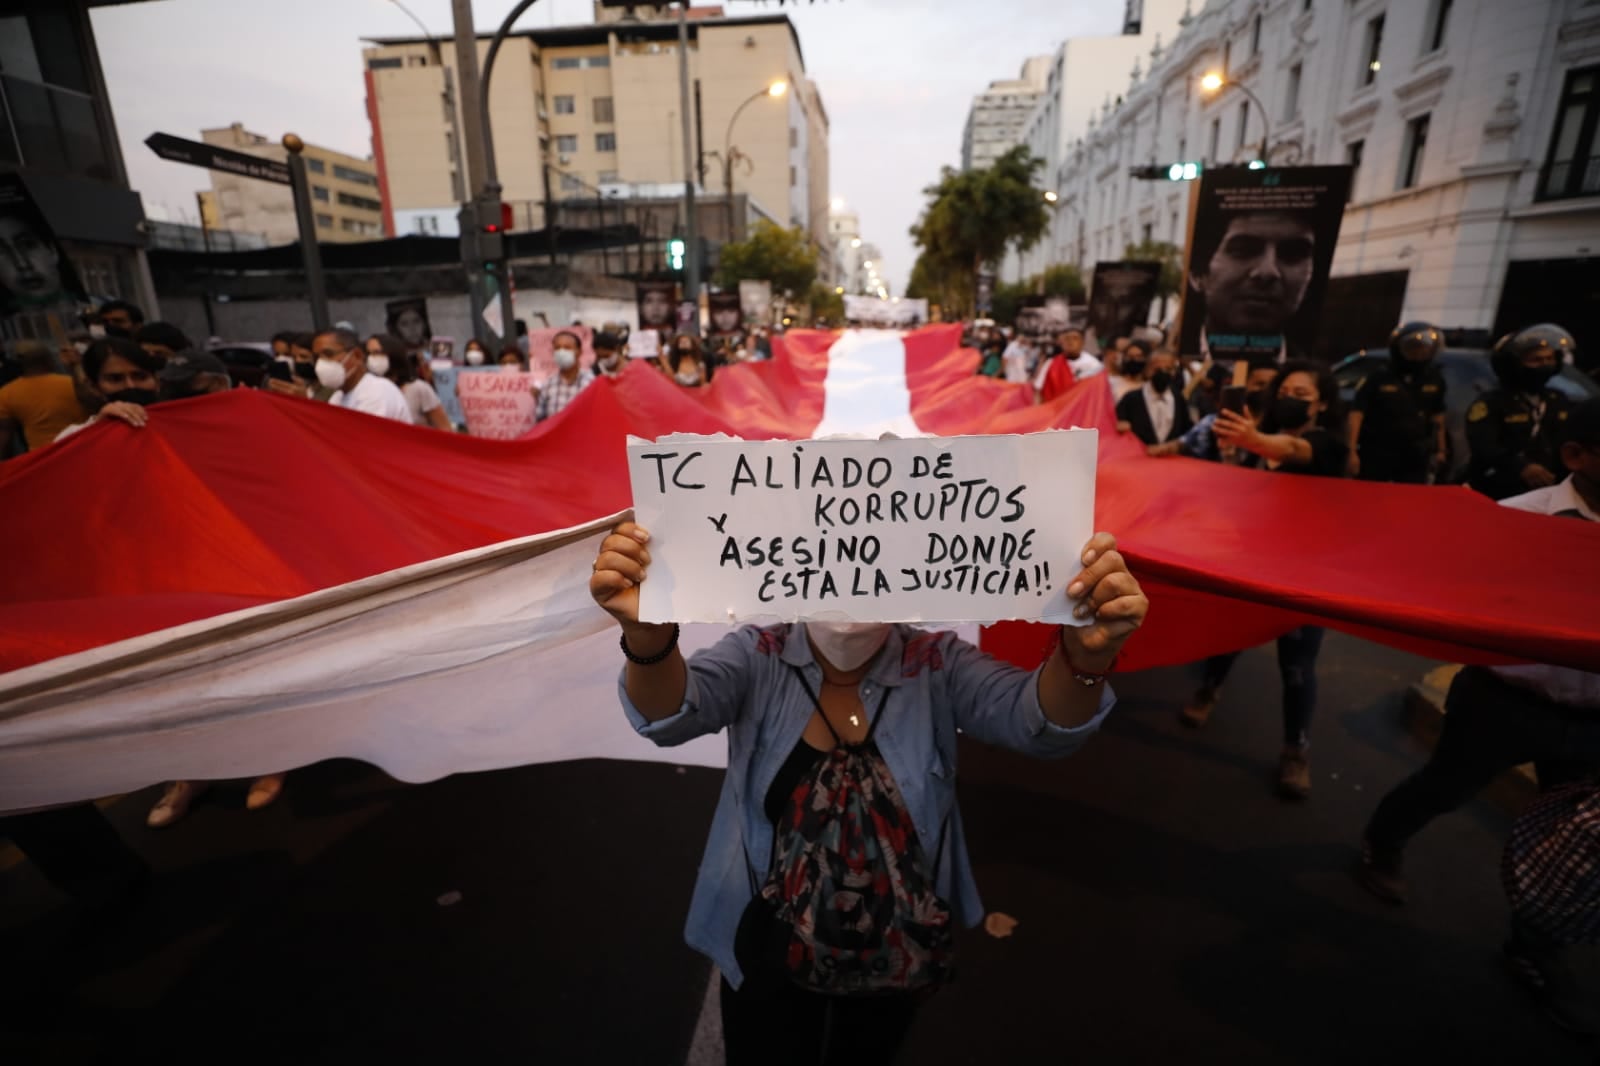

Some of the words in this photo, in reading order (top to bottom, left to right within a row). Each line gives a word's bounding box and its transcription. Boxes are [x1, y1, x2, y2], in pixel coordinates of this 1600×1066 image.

[641, 452, 706, 494] TC
[730, 445, 892, 496] ALIADO
[909, 452, 954, 480] DE
[814, 478, 1027, 527] KORRUPTOS
[719, 529, 881, 570] ASESINO
[924, 528, 1036, 570] DONDE
[758, 566, 839, 603] ESTA
[851, 567, 891, 597] LA
